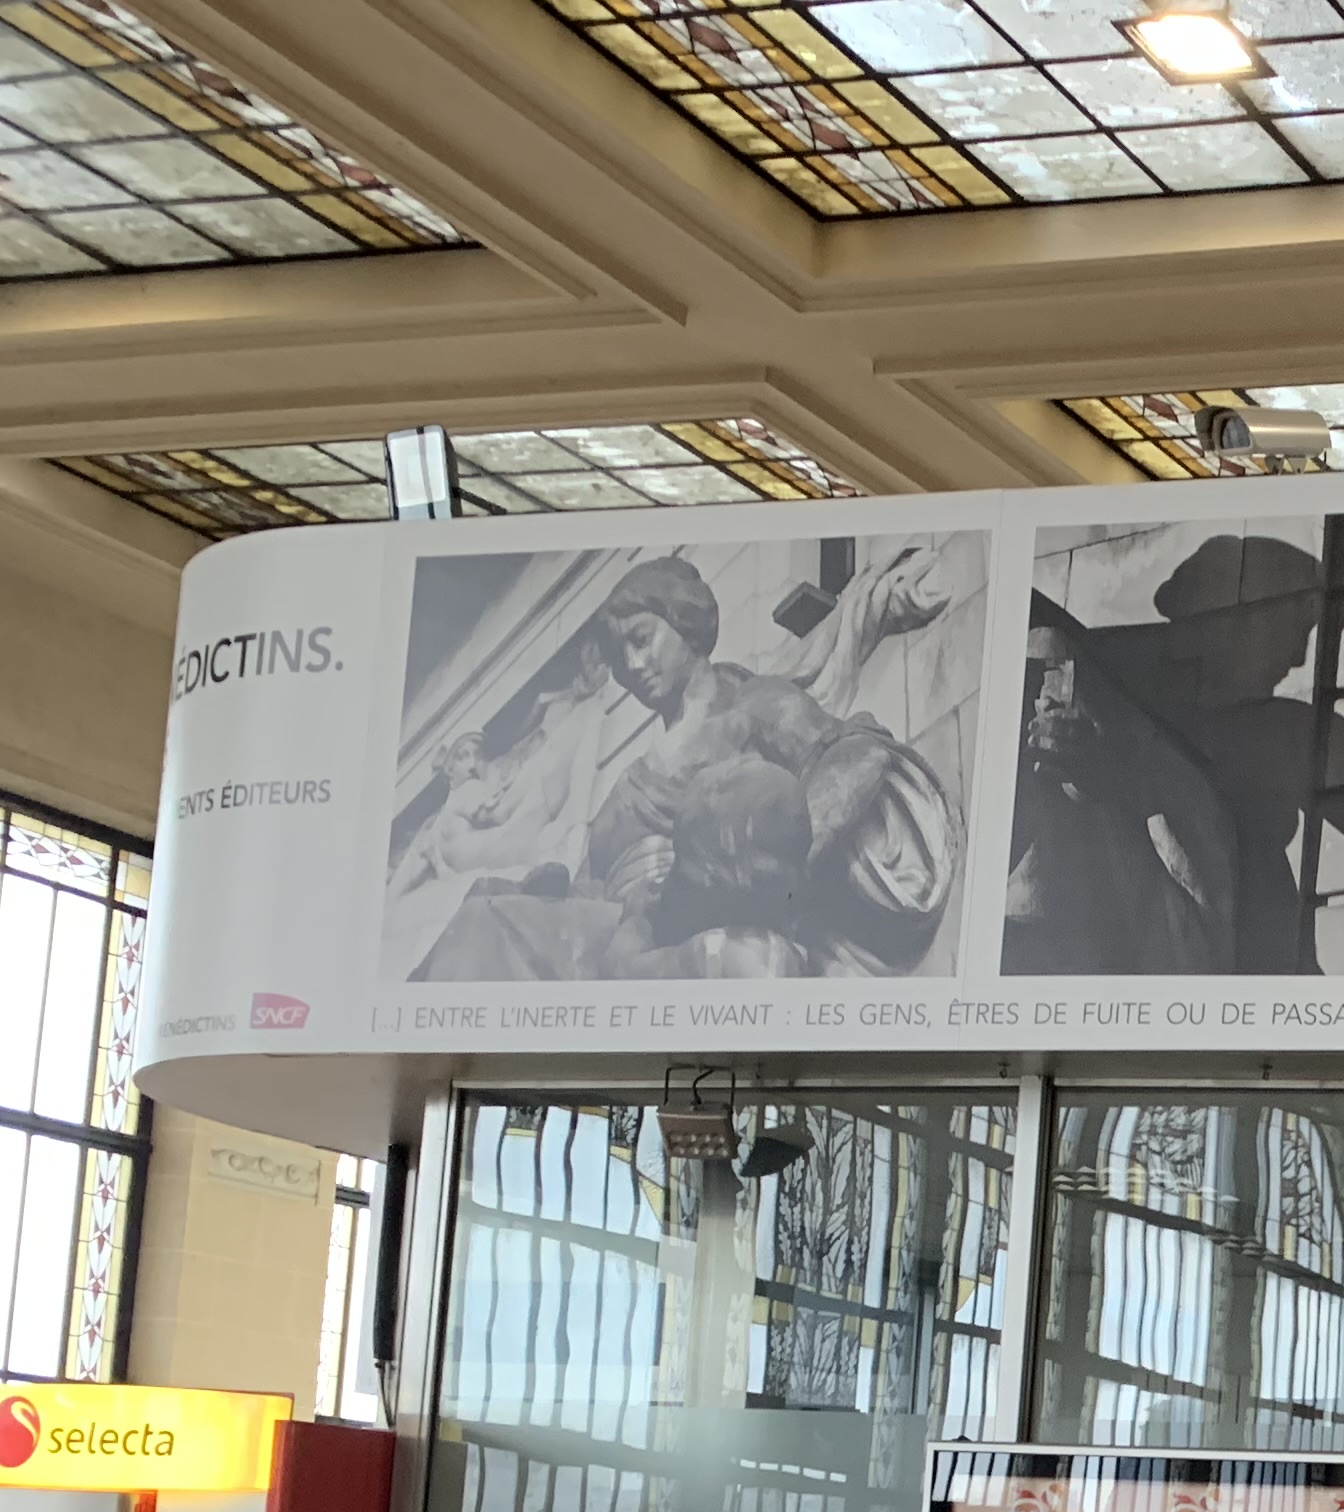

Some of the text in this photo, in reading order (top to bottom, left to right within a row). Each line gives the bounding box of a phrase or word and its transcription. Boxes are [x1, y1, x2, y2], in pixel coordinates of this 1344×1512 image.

[170, 625, 343, 704] ÉDICTINS.
[220, 779, 331, 808] ÉDITEURS
[252, 1005, 306, 1026] SNCF
[415, 1007, 486, 1028] ENTRE
[501, 1006, 596, 1028] L'INERTE
[610, 1006, 638, 1027] ET
[651, 1005, 676, 1026] LE
[689, 1004, 773, 1025] VIVANT
[806, 1003, 845, 1025] LES
[860, 1003, 931, 1028] GENS,
[948, 998, 1019, 1026] ÊTRES
[1034, 1002, 1067, 1024] DE
[1083, 1002, 1151, 1025] FUITE
[1166, 1002, 1205, 1025] OU
[1222, 1002, 1256, 1025] DE
[47, 1422, 175, 1457] selecta
